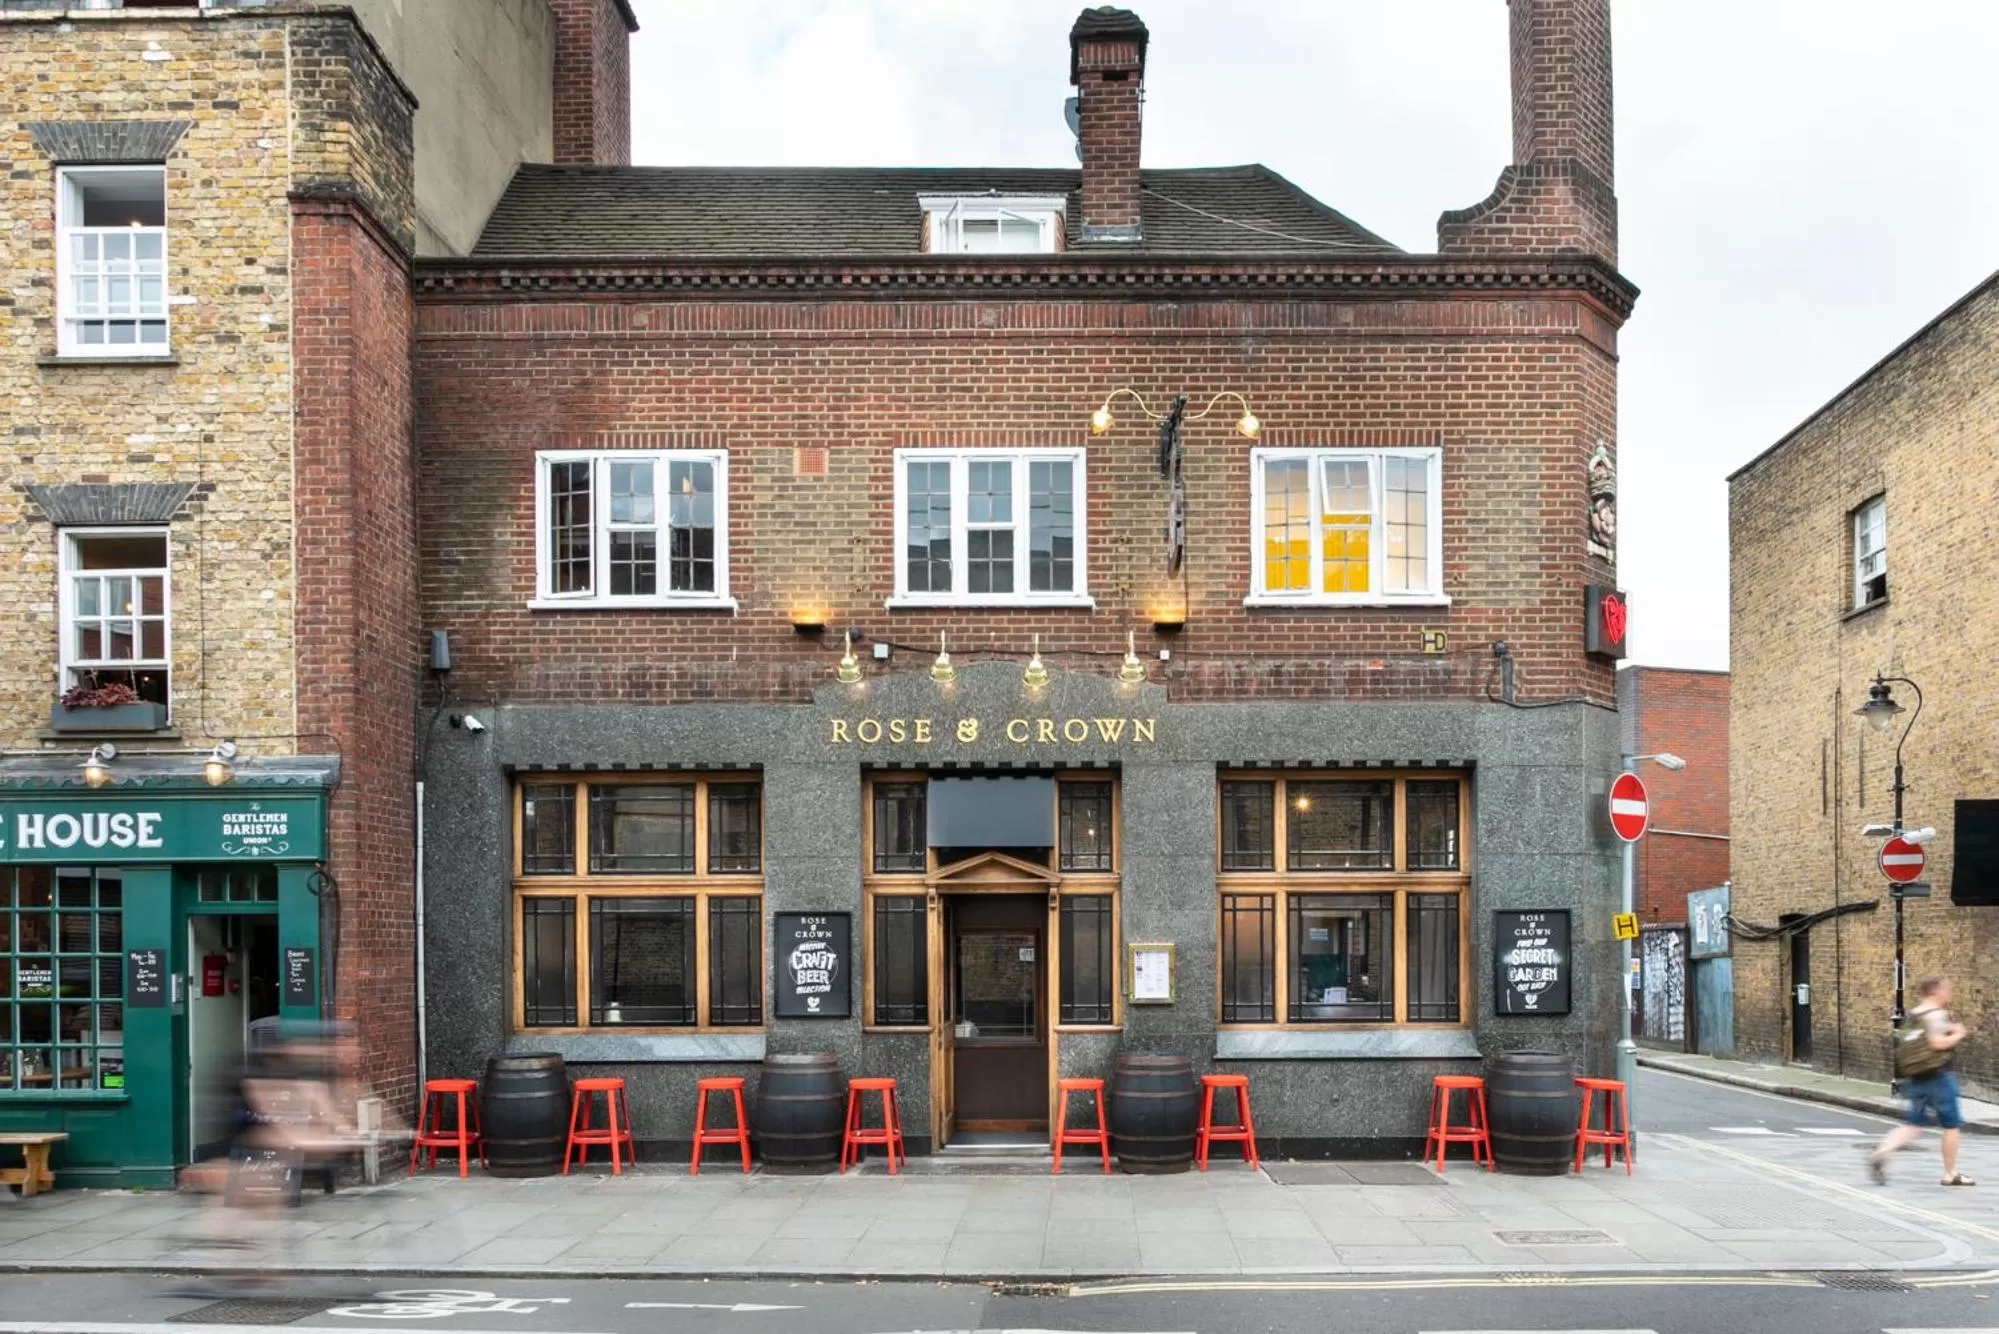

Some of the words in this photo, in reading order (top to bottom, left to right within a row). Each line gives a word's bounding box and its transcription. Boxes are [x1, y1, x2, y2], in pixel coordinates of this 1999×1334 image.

[830, 718, 933, 744] ROSE
[956, 717, 979, 743] &
[1006, 718, 1156, 743] CROWN
[222, 813, 288, 823] GENTLEMEN
[16, 812, 164, 849] HOUSE
[223, 824, 288, 835] BARISTAS
[800, 917, 827, 925] ROSE
[1616, 915, 1636, 937] H
[1514, 928, 1551, 936] CROWN
[792, 950, 837, 970] CRAFT
[1511, 948, 1555, 965] SECRET
[797, 969, 830, 985] BEER
